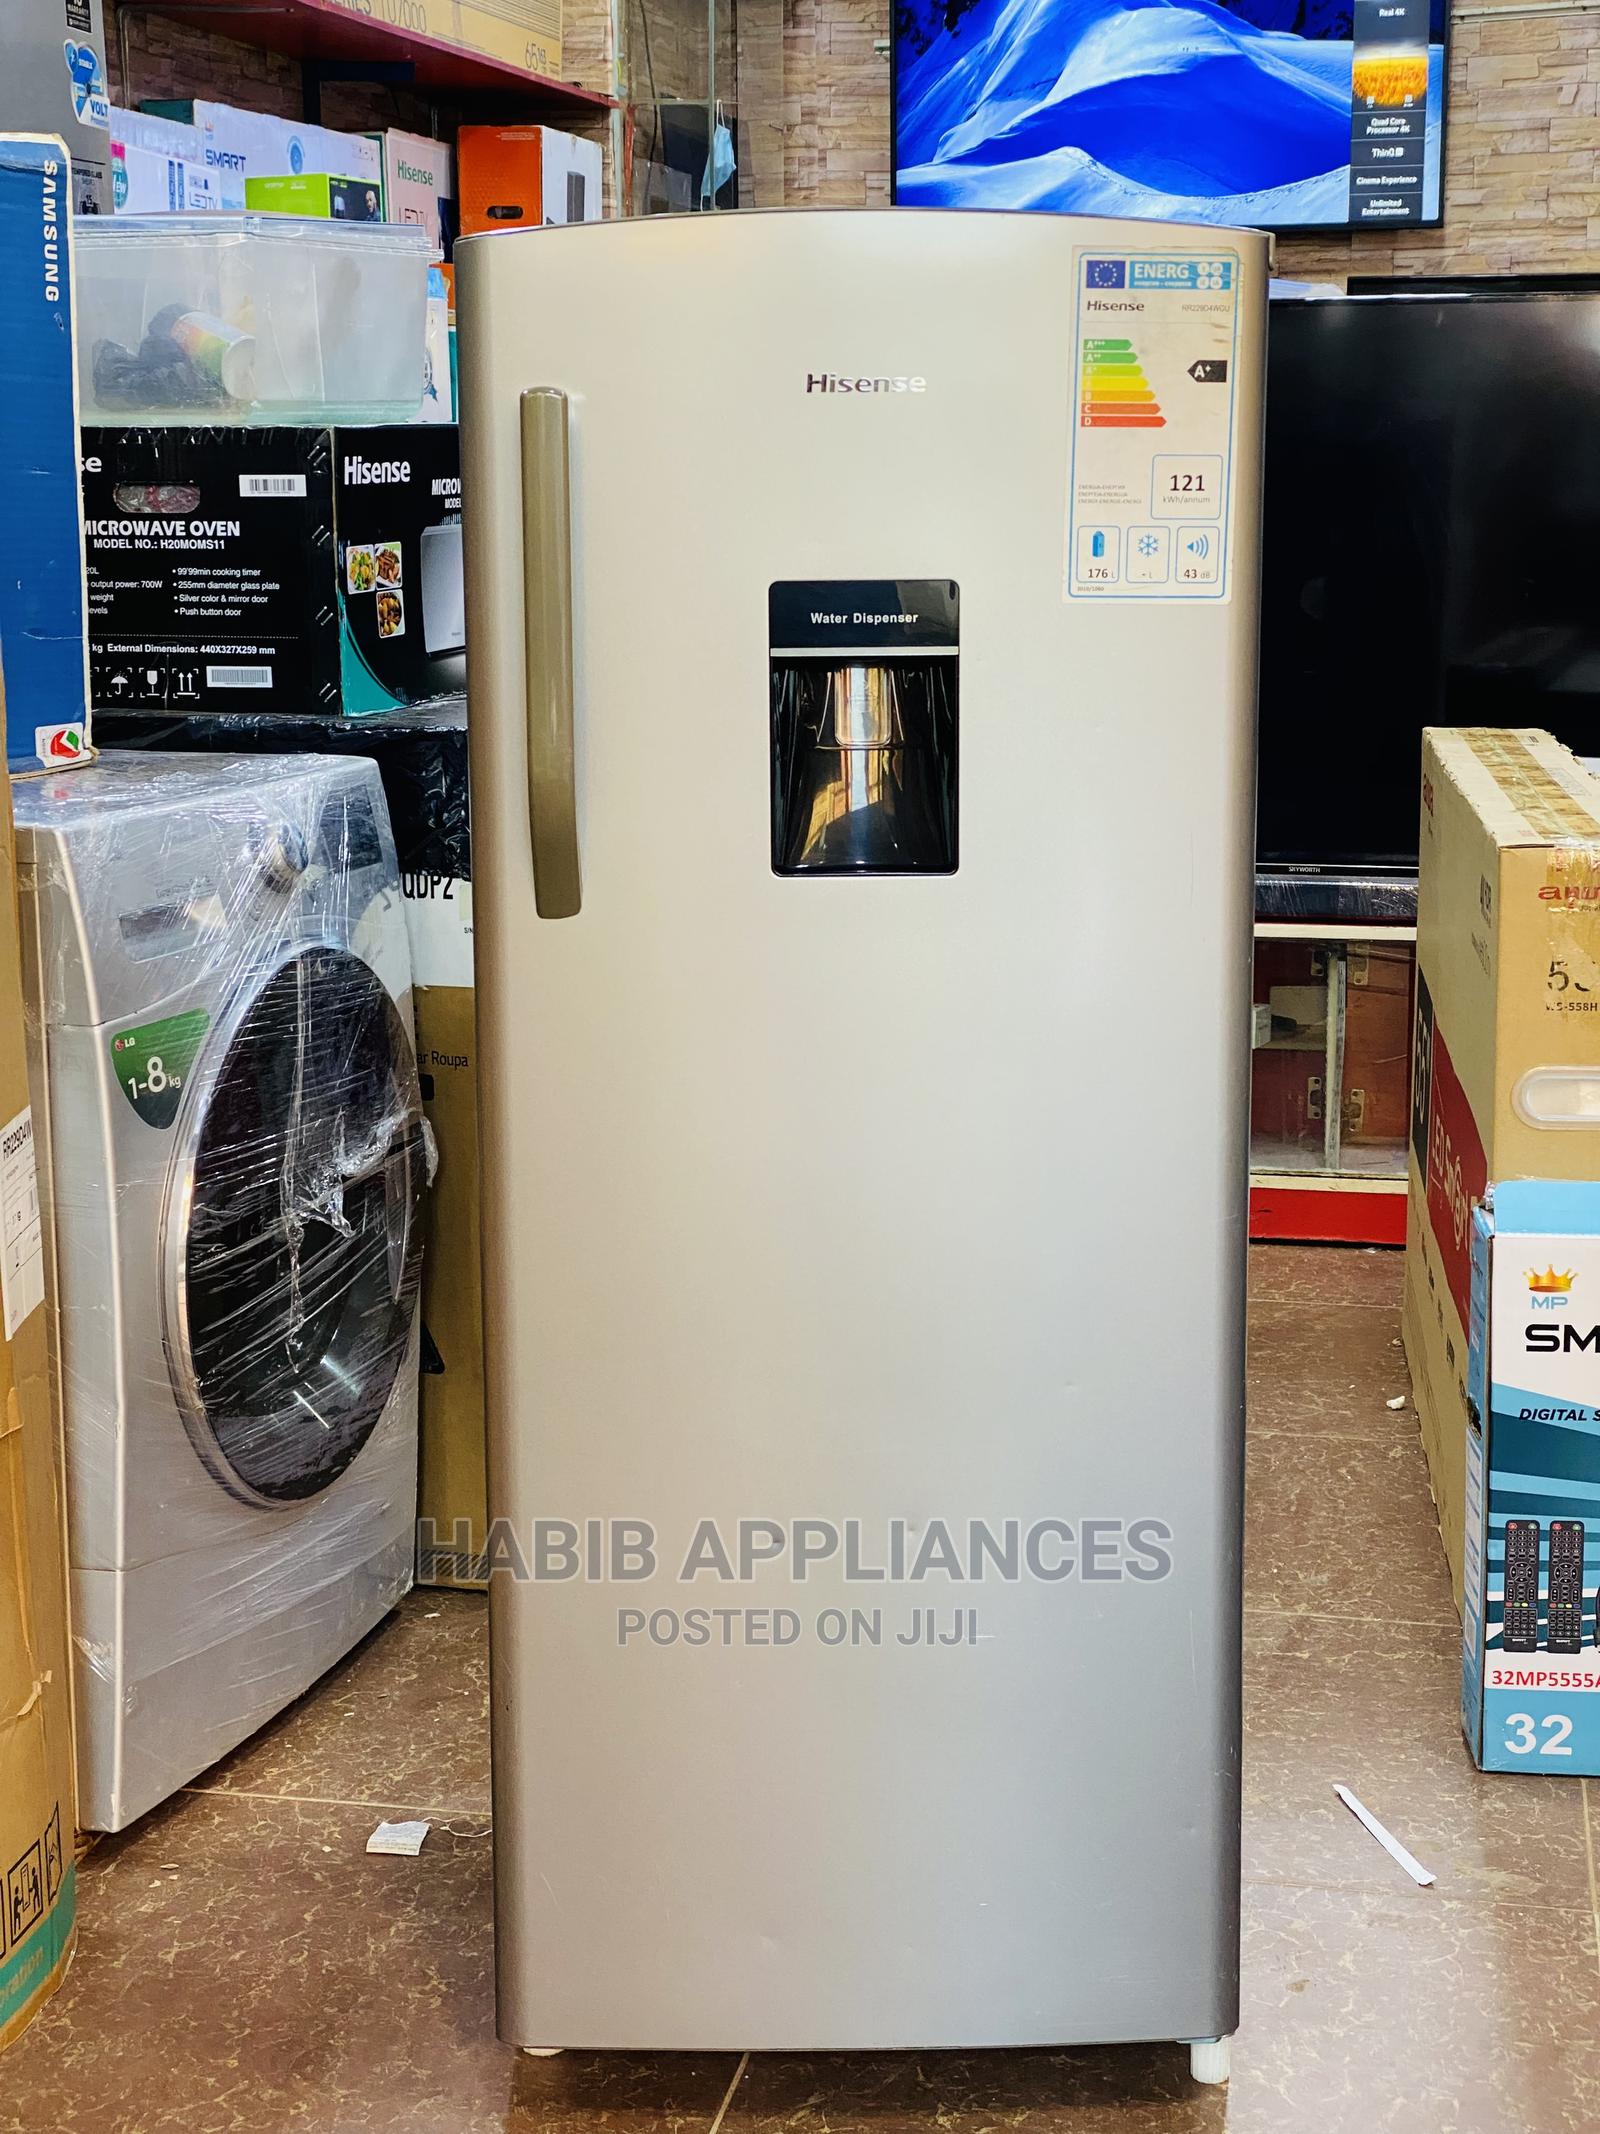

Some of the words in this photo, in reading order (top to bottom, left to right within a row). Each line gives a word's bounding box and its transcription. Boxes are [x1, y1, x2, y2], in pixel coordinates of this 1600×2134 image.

[90, 100, 108, 117] VOLT
[205, 149, 246, 172] SMART
[397, 160, 434, 186] Hisense
[43, 159, 60, 302] SAMSUNG
[1134, 263, 1189, 279] ENERG
[1087, 301, 1145, 312] Hisense
[806, 374, 927, 393] Hisense
[1084, 404, 1091, 413] C
[1084, 417, 1092, 426] D
[344, 456, 411, 485] Hisense
[431, 478, 461, 495] MICRO
[1170, 475, 1205, 492] 121
[189, 520, 241, 536] OVEN
[93, 538, 132, 549] MODEL
[135, 539, 158, 549] NO.:
[160, 539, 226, 550] H20MOMS11
[212, 567, 241, 577] cooking
[242, 568, 261, 577] timer
[1088, 569, 1108, 578] 176
[1184, 569, 1197, 578] 43
[90, 581, 114, 589] output
[114, 582, 140, 590] power:
[141, 580, 163, 589] 700W
[178, 581, 206, 590] 255mm
[207, 581, 239, 590] diameter
[240, 582, 260, 591] glass
[261, 582, 280, 591] plate
[90, 593, 114, 602] weight
[179, 593, 200, 603] Silver
[201, 594, 219, 603] color
[228, 595, 250, 603] mirror
[252, 595, 269, 603] door
[89, 606, 109, 615] evels
[179, 607, 198, 616] Push
[200, 607, 223, 616] button
[224, 608, 242, 616] door
[810, 612, 848, 624] Water
[853, 612, 919, 625] Dispenser
[92, 643, 103, 653] kg
[107, 643, 143, 653] External
[144, 643, 199, 654] Dimensions:
[200, 645, 257, 655] 440X327X259
[259, 647, 276, 655] mm
[124, 1037, 136, 1048] LG
[431, 1050, 469, 1071] Roupa
[168, 1075, 181, 1089] kg
[1531, 1296, 1568, 1309] MP
[1519, 1408, 1587, 1422] DIGITAL
[1504, 1712, 1573, 1756] 32
